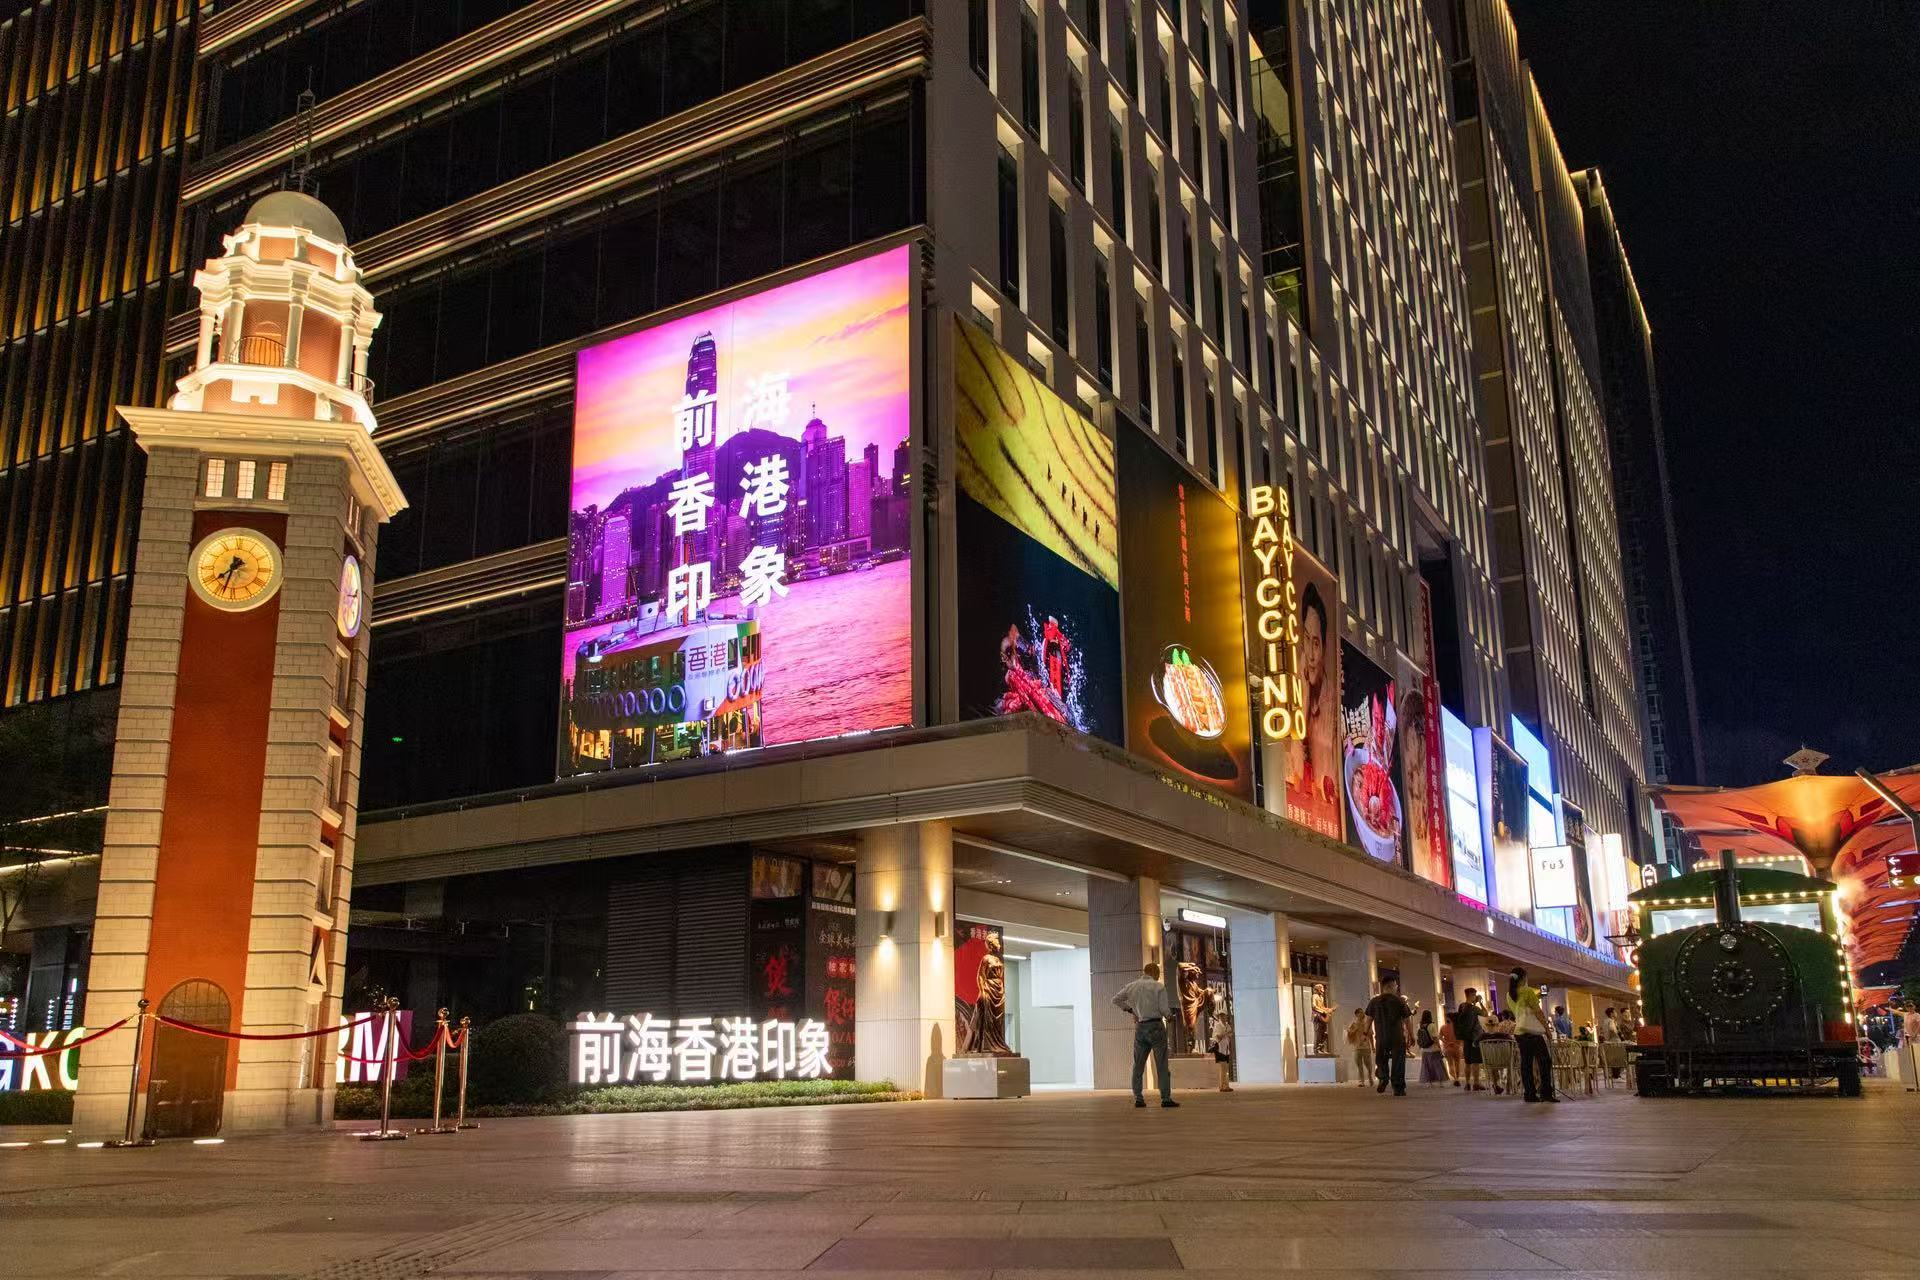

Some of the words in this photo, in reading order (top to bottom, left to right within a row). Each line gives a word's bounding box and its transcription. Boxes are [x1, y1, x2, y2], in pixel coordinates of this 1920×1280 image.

[672, 370, 792, 452] 前海
[666, 452, 791, 538] 香港
[664, 544, 792, 623] 印象
[1249, 484, 1292, 741] BAYCCINO
[1278, 484, 1307, 742] BAYCCINO
[687, 641, 727, 672] 香港
[566, 1011, 834, 1084] 前海香港印象
